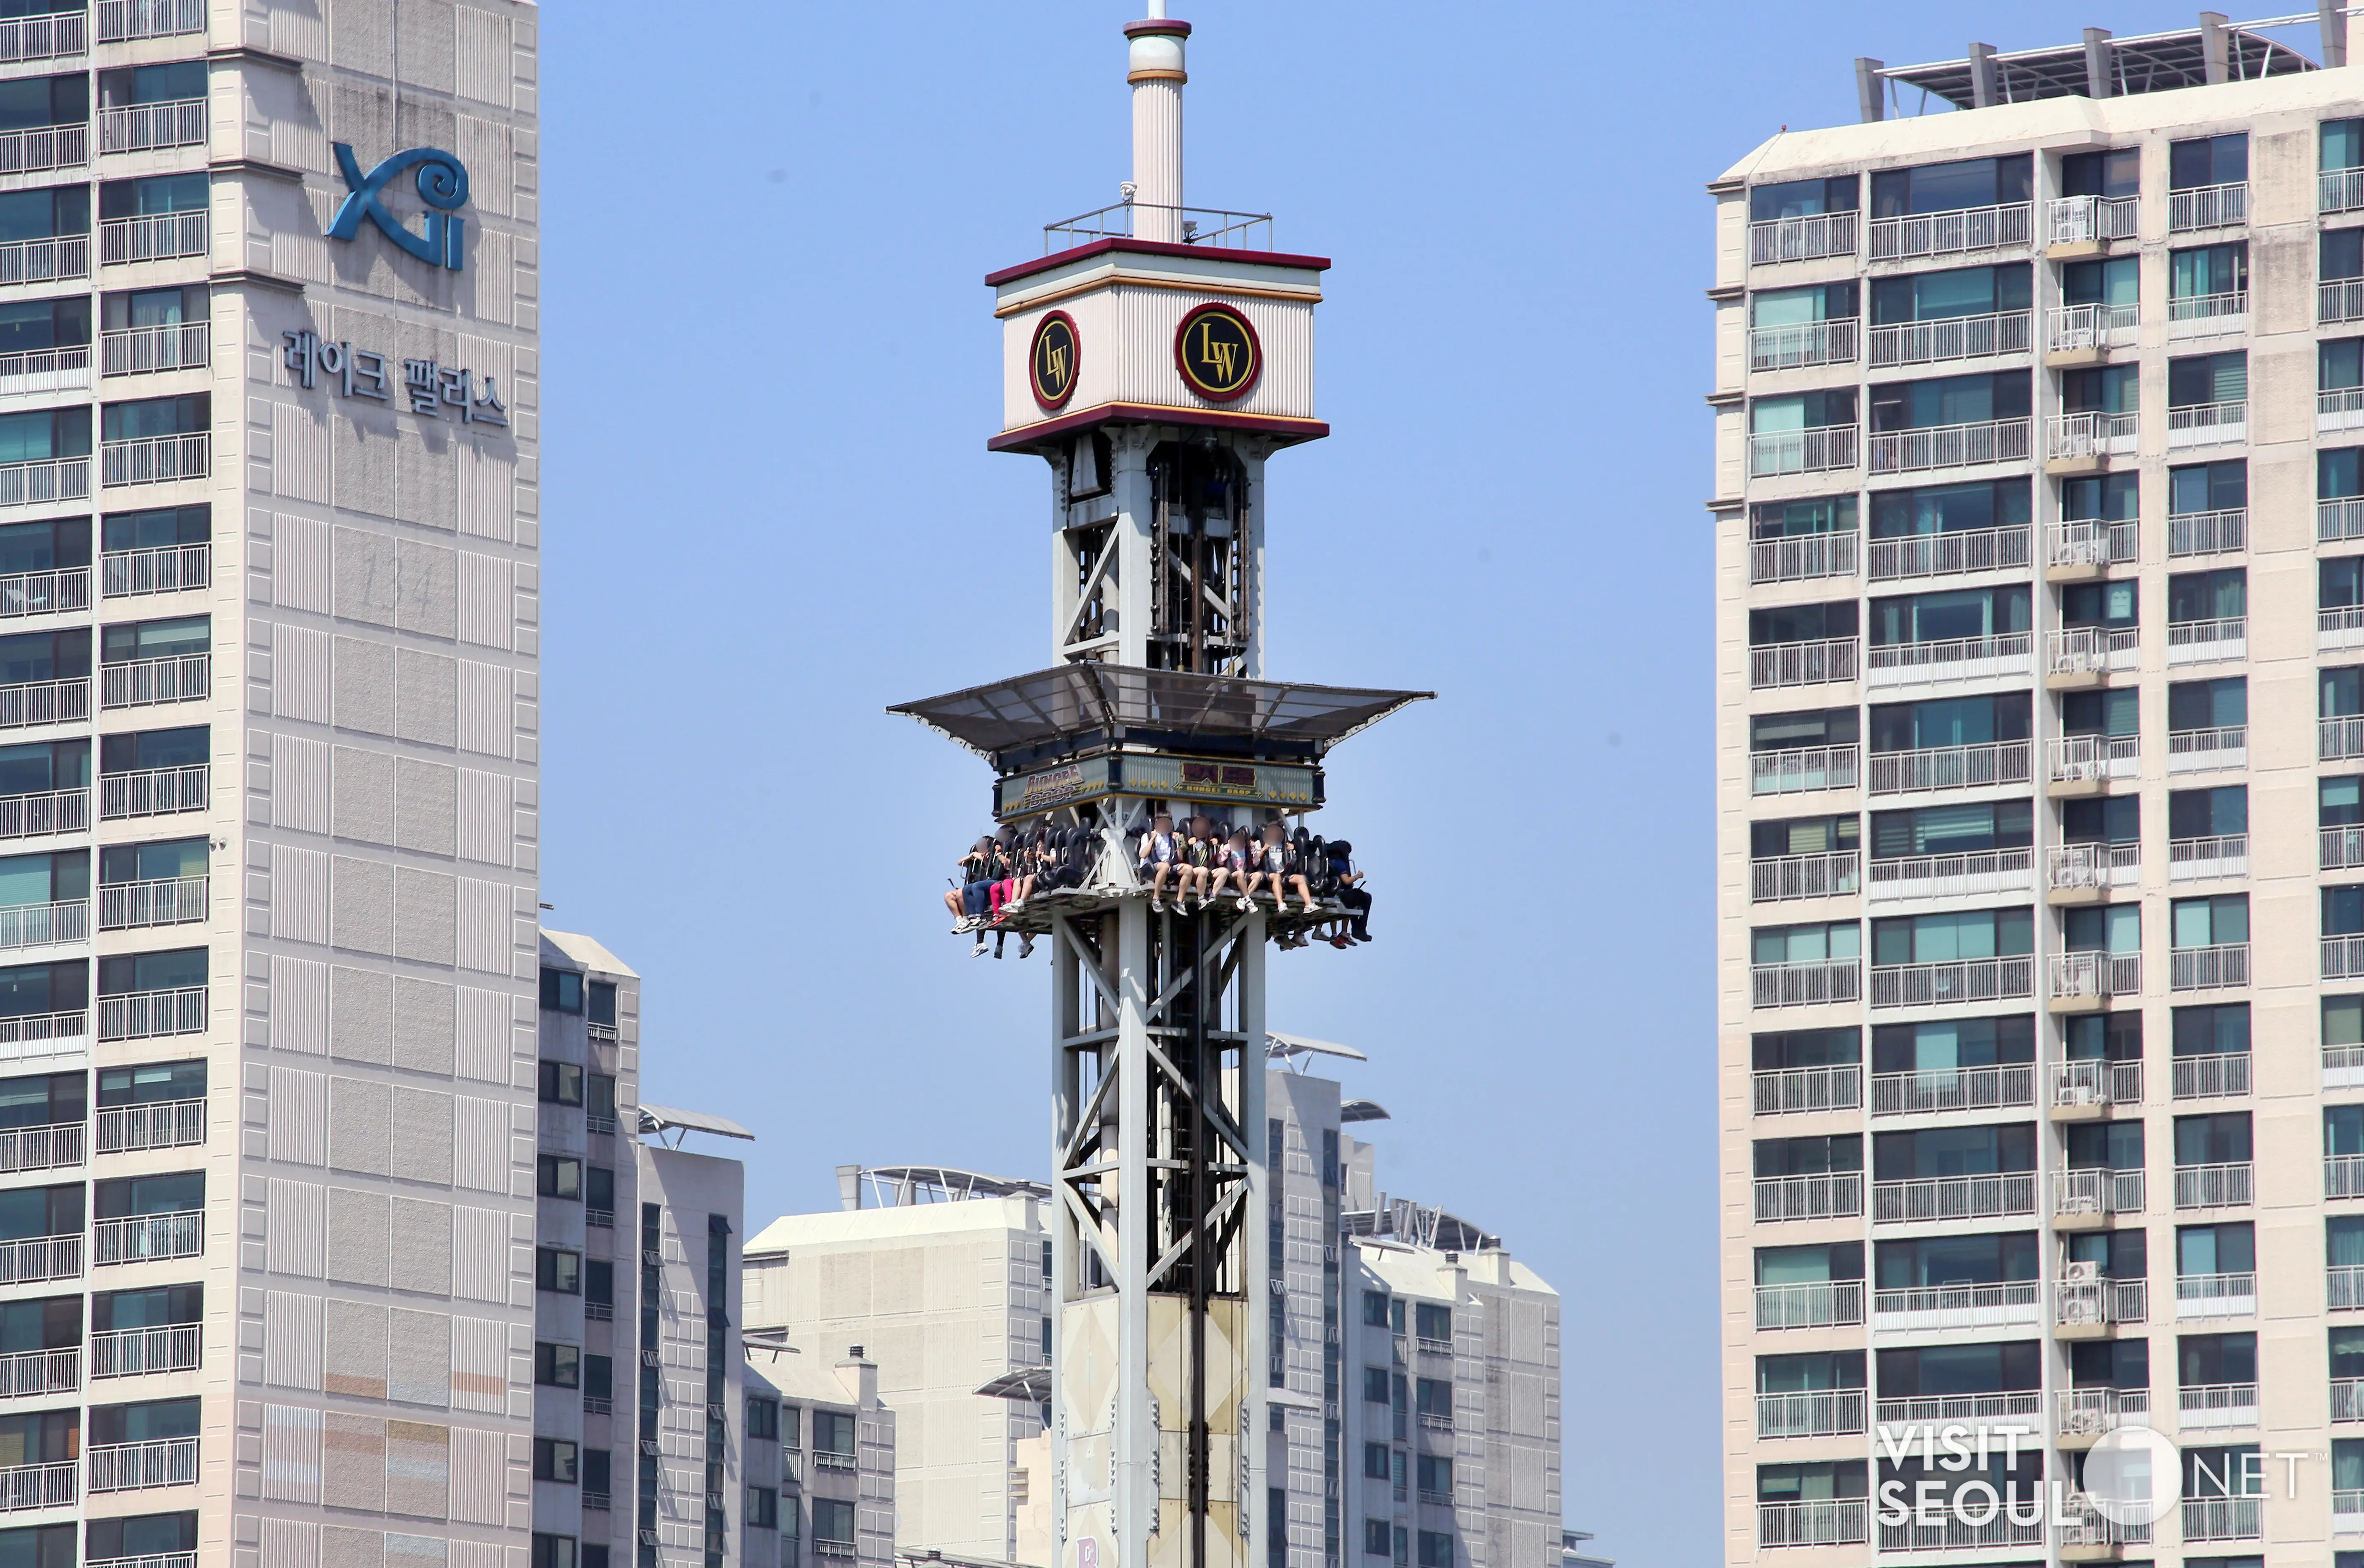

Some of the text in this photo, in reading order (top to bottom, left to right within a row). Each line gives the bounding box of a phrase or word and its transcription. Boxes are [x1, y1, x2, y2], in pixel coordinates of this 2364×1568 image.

[282, 331, 508, 426] 레이크 팰리스
[1029, 785, 1075, 808] DROP
